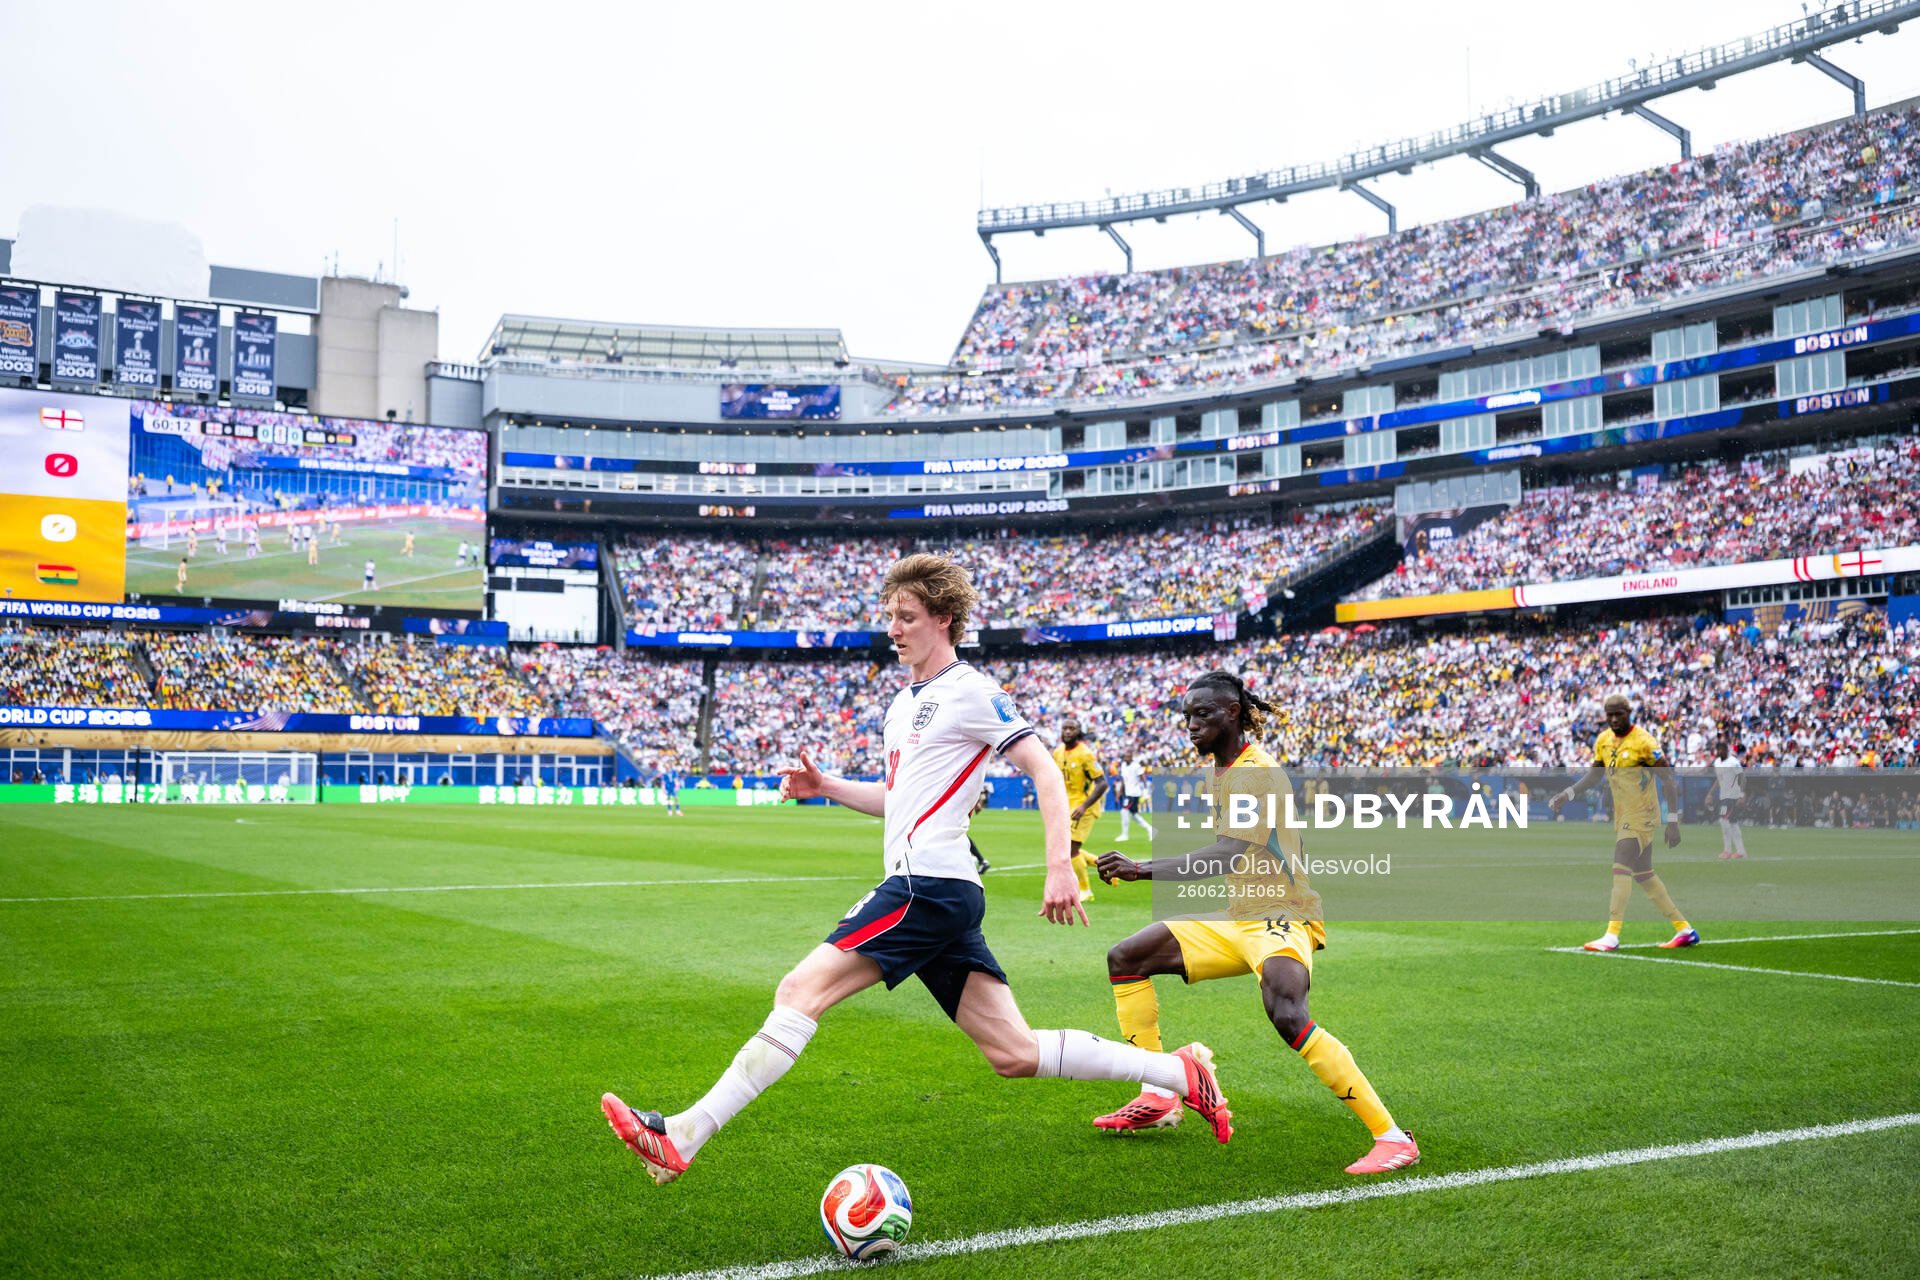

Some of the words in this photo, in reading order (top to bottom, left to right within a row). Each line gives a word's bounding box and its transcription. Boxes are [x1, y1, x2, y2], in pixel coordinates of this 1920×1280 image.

[1794, 326, 1868, 354] BOSTON
[0, 354, 34, 363] HAMPIONS
[64, 353, 90, 361] WORLD
[56, 366, 96, 378] 2004
[120, 373, 154, 384] 2014
[180, 378, 213, 390] 2016
[238, 384, 270, 396] 2018
[1796, 388, 1870, 414] BOSTON
[152, 419, 192, 433] 60:12
[1228, 432, 1279, 450] BOSTON
[699, 462, 756, 474] BOSTON
[924, 461, 952, 474] FIFA
[952, 458, 998, 472] WORLD
[998, 457, 1024, 470] CUP
[698, 504, 756, 516] BOSTON
[924, 504, 952, 516] FIFA
[952, 502, 998, 516] WORLD
[998, 501, 1024, 514] CUP
[1024, 500, 1069, 512] 2026
[1430, 526, 1453, 540] FIFA
[1623, 576, 1678, 592] ENGLAND
[0, 602, 29, 614] FIFA
[31, 602, 82, 616] WORLD
[83, 604, 111, 618] CUP
[112, 606, 160, 620] 2026
[316, 614, 370, 628] BOSTON
[1131, 620, 1172, 636] WORLD
[1172, 618, 1196, 632] CUP
[0, 708, 48, 724] ORLD
[50, 710, 86, 724] CUP
[350, 715, 420, 731] BOSTON
[1264, 914, 1292, 934] 14
